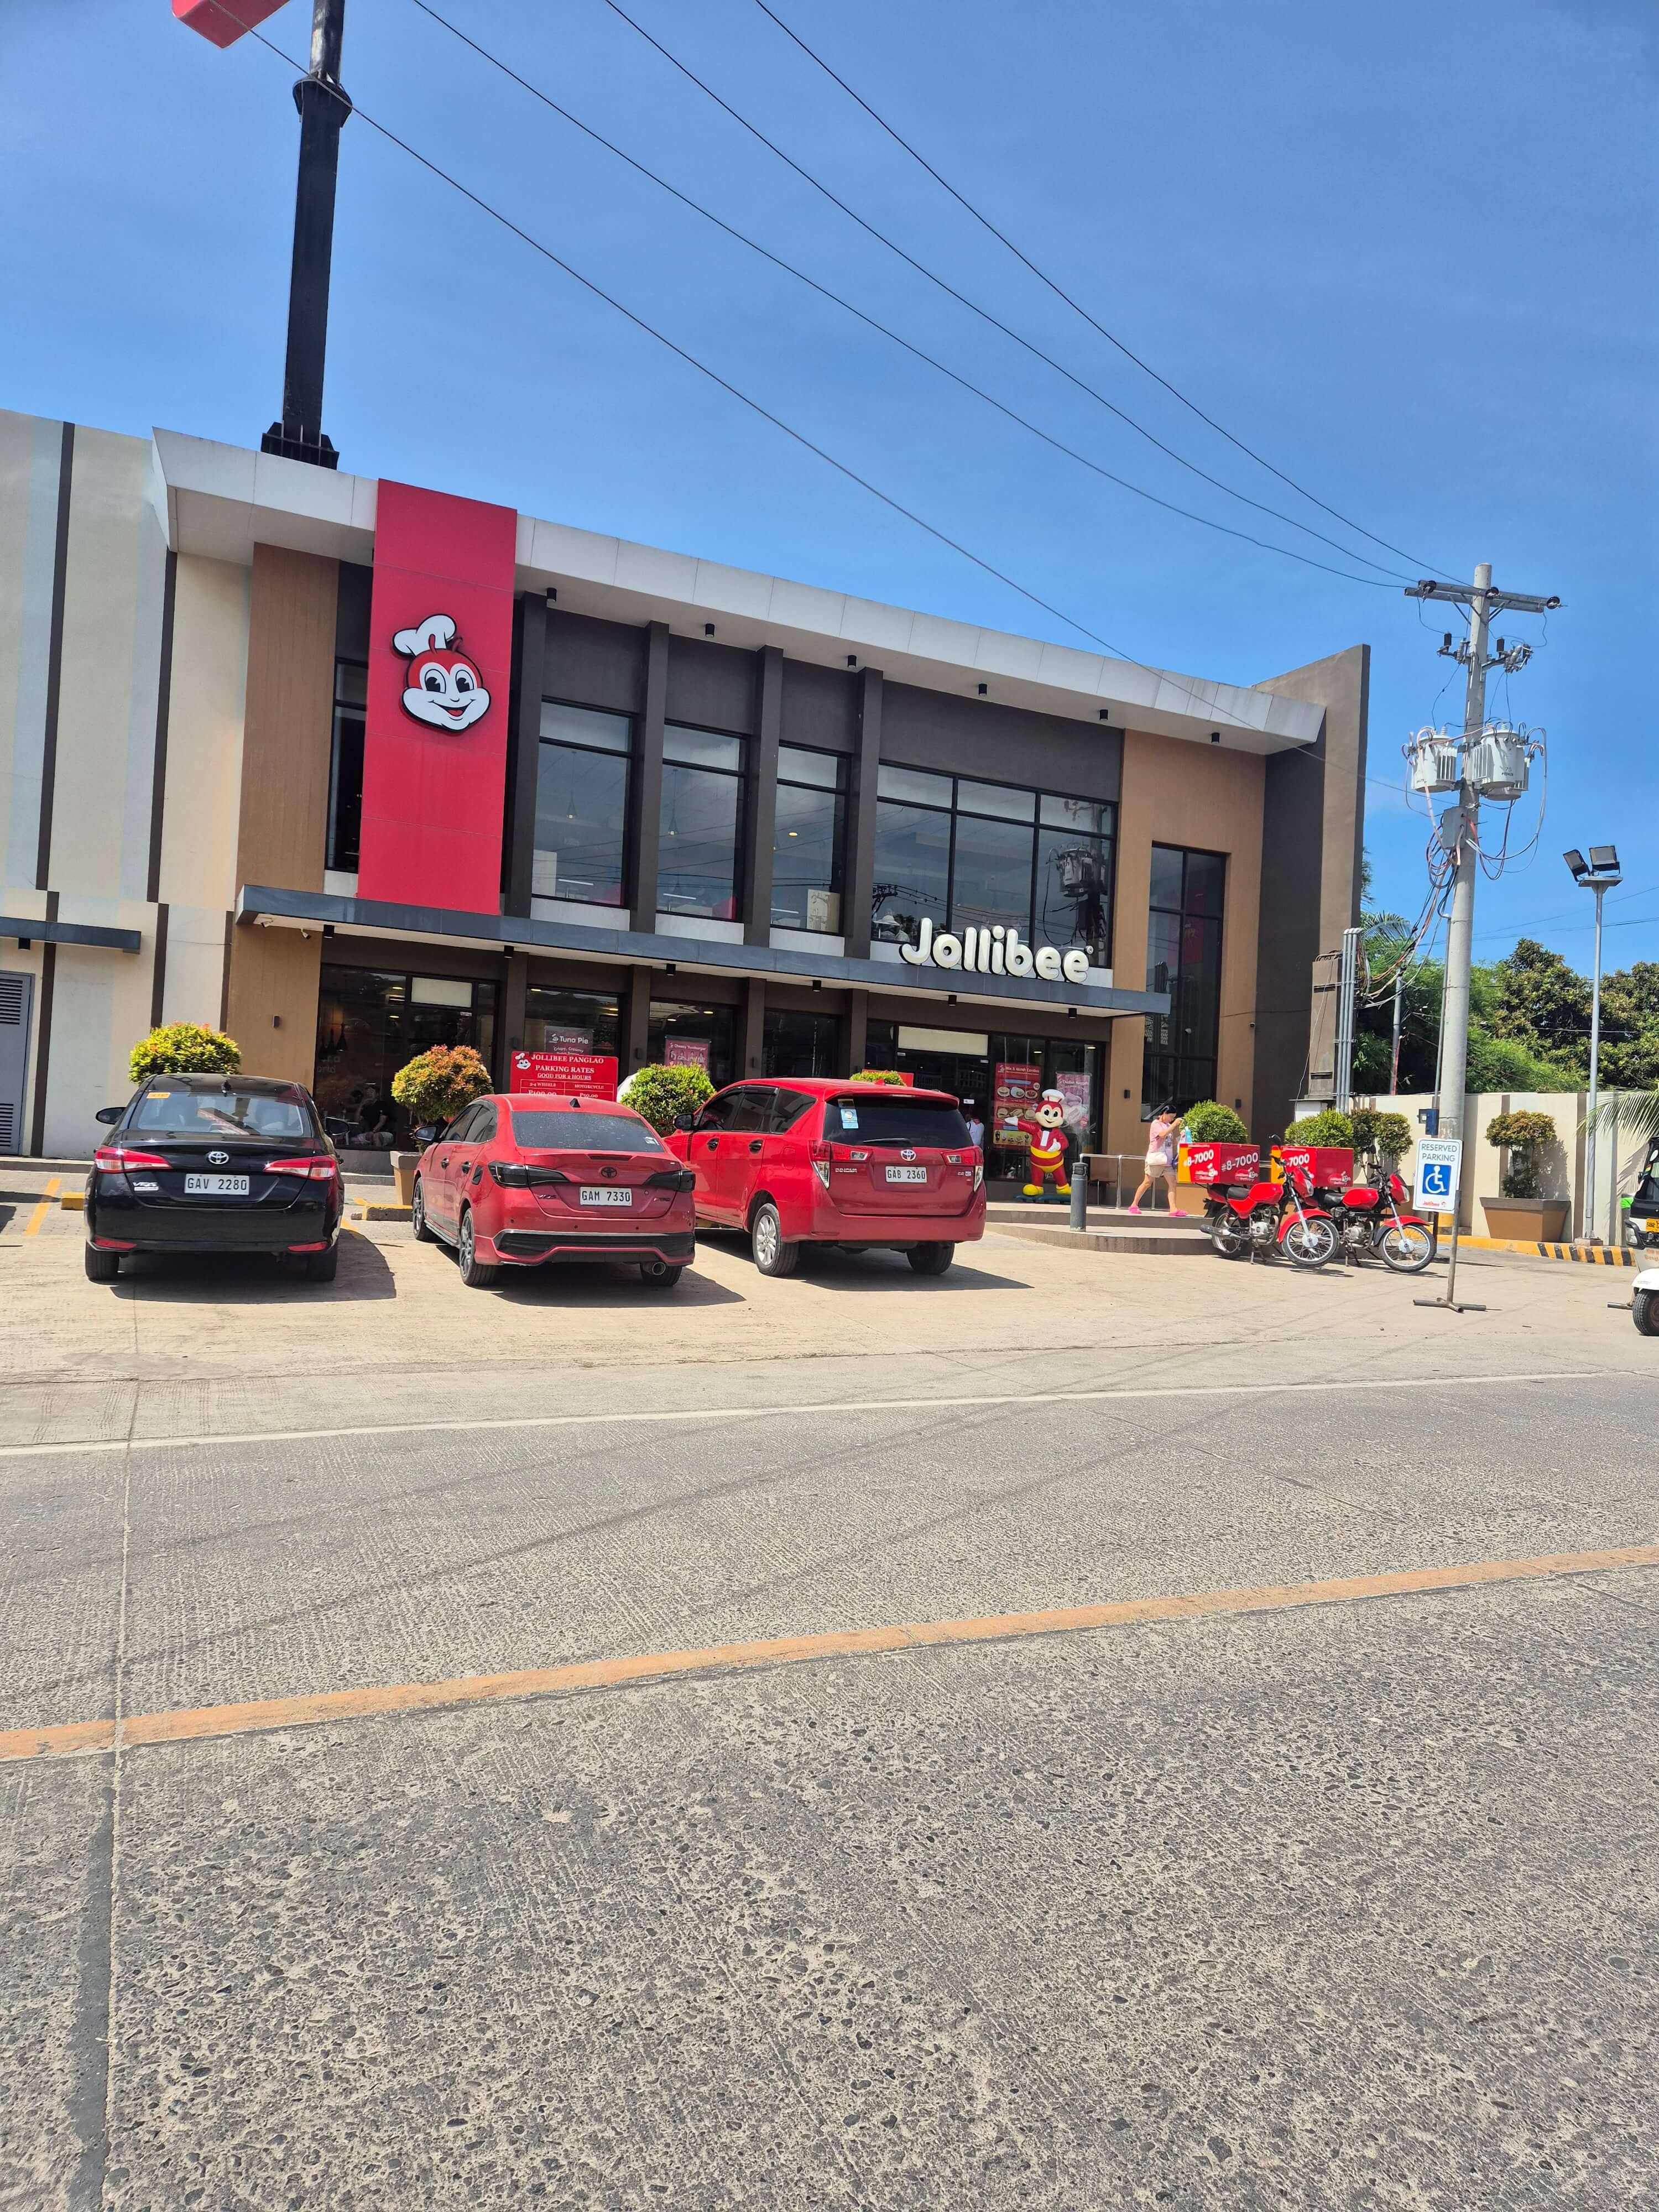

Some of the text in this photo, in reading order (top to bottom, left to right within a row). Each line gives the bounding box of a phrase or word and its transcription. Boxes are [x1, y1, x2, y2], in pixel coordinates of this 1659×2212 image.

[899, 917, 1089, 983] Jollibee
[1421, 1144, 1457, 1152] RESERVED
[1183, 1149, 1214, 1167] #8-7000
[1221, 1152, 1259, 1172] #8-7000
[1422, 1153, 1455, 1162] PARKING
[887, 1170, 926, 1180] GAB 2360
[187, 1177, 247, 1191] GAV 2280
[582, 1191, 630, 1202] GAM 7330
